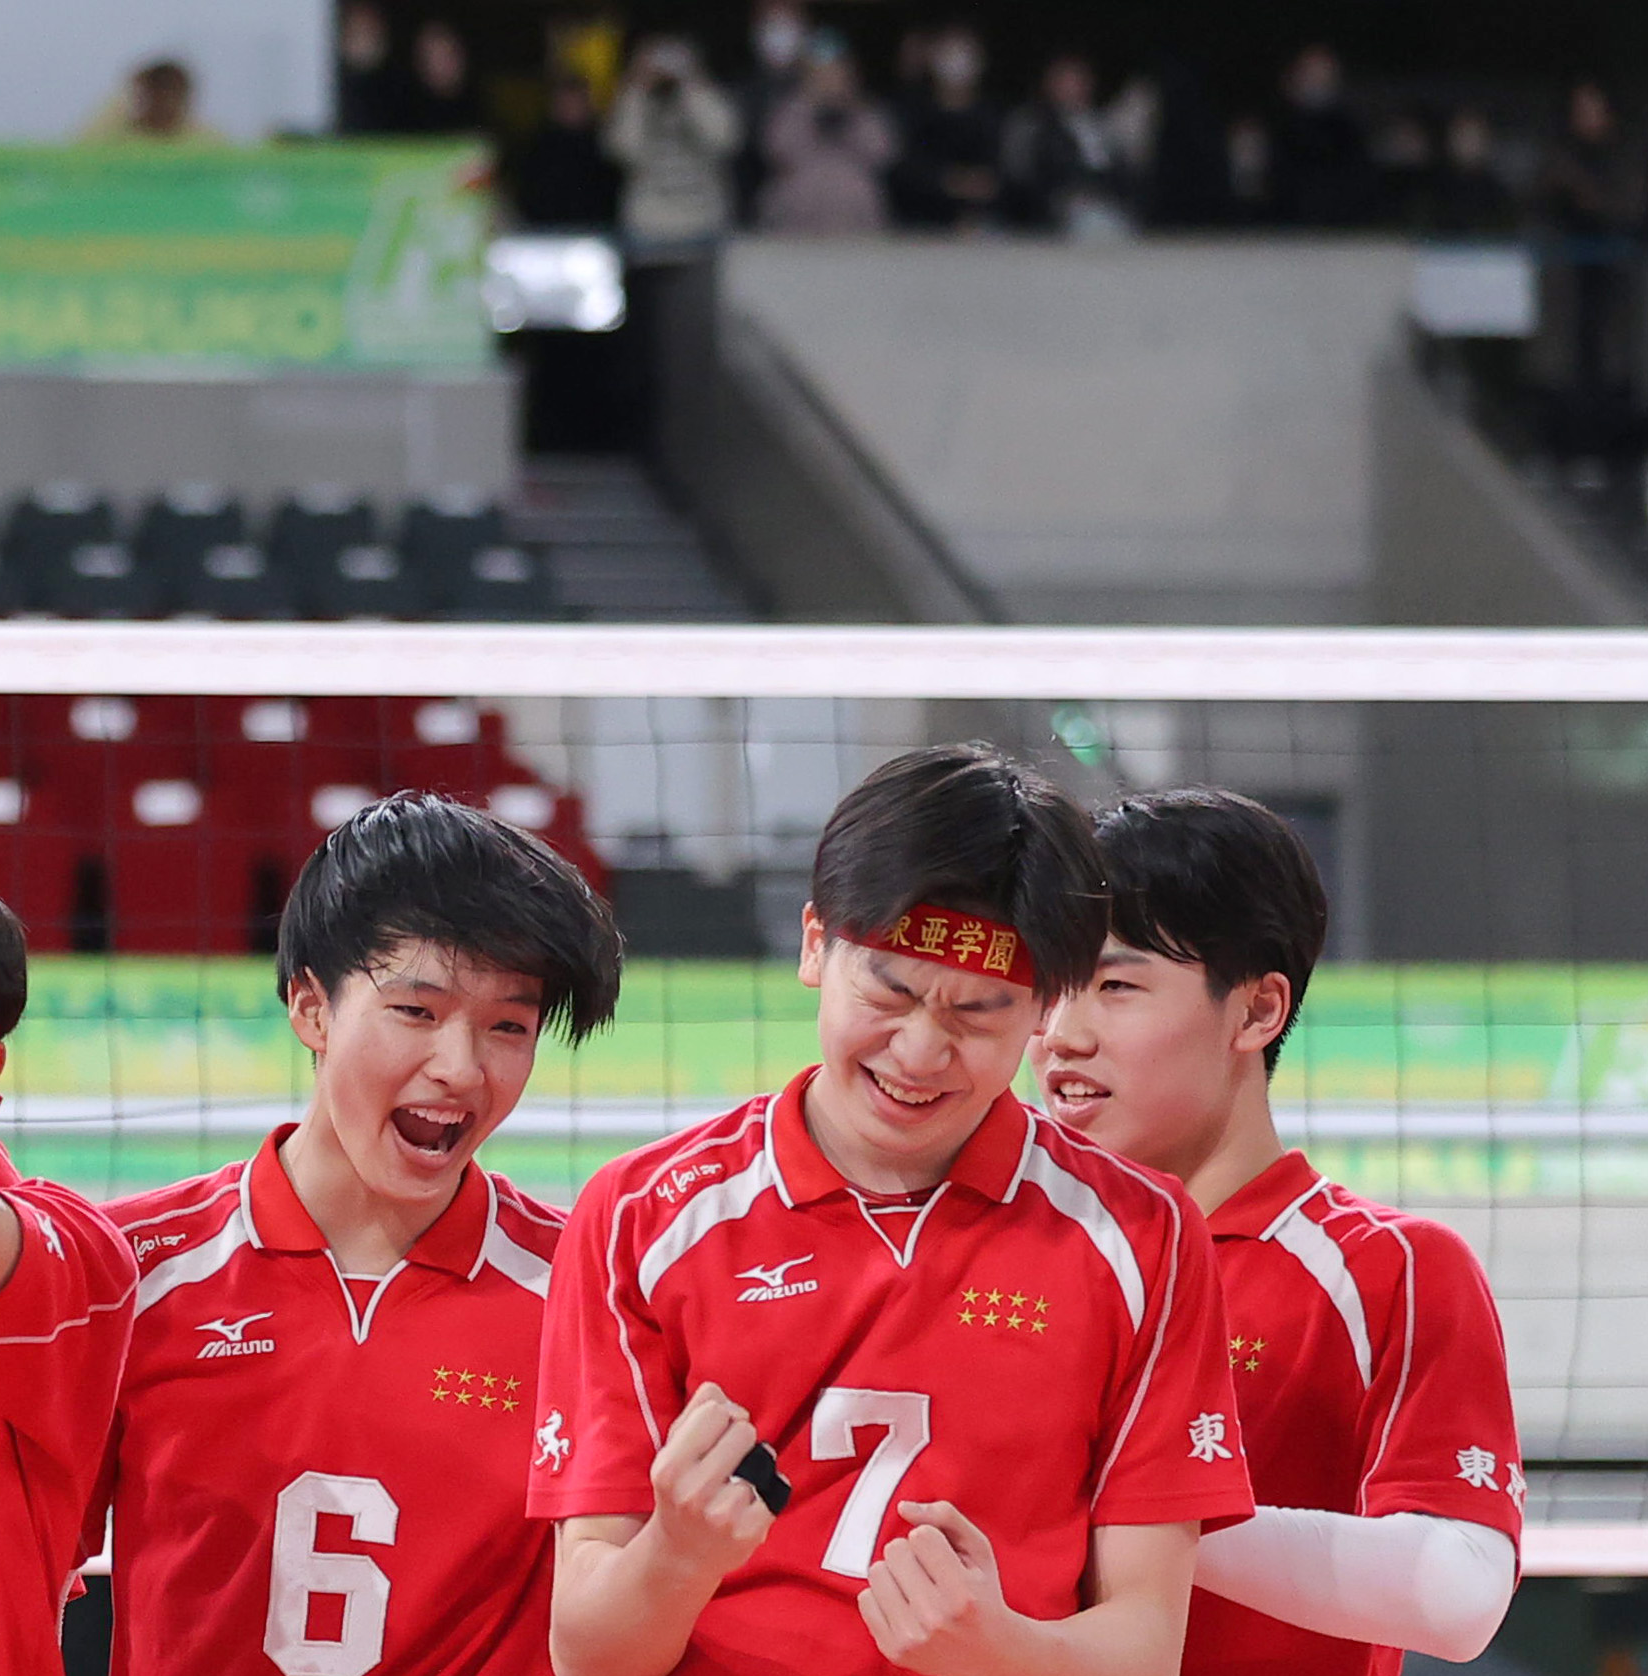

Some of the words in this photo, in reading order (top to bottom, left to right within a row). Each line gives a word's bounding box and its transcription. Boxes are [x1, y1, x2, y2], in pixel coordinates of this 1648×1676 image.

[885, 914, 1018, 976] 東亜学園
[736, 1279, 818, 1303] MIZUNO
[196, 1338, 275, 1359] MIZUNO
[811, 1387, 931, 1579] 7
